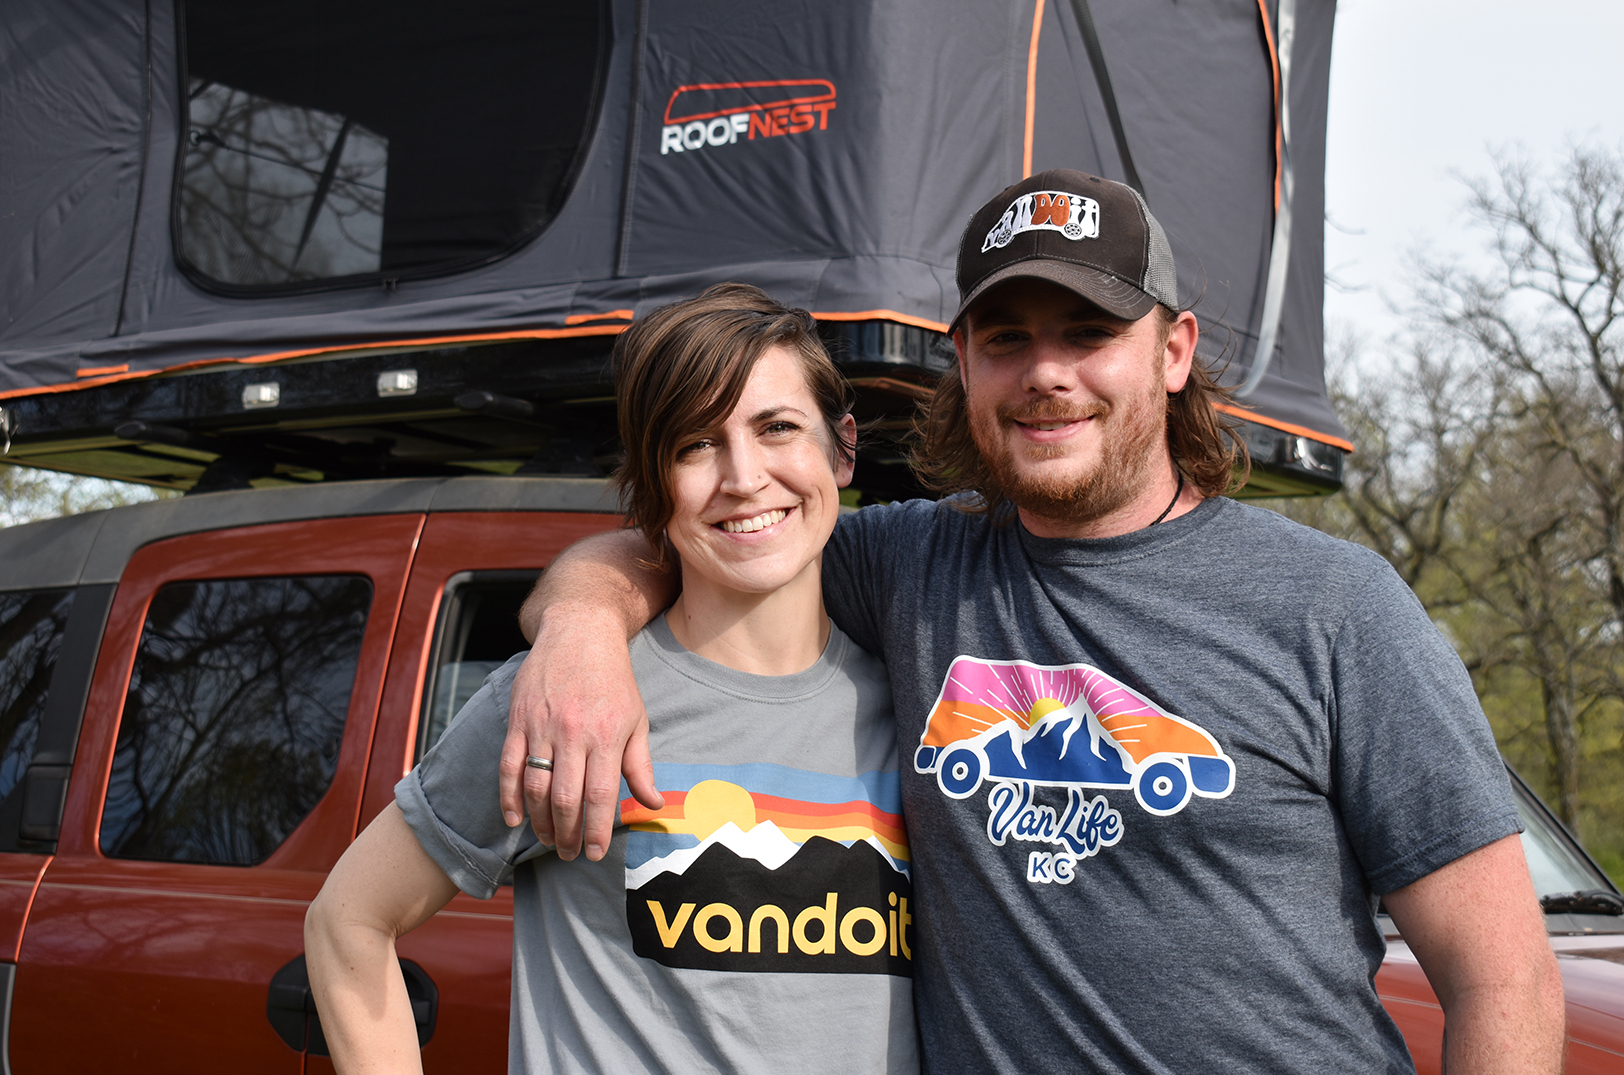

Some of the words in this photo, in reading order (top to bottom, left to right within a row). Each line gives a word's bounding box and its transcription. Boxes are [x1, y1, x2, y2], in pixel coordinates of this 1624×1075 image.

[660, 101, 837, 155] ROOFNEST
[989, 780, 1053, 843] Van
[1056, 788, 1120, 856] Life
[1030, 855, 1072, 881] KC
[646, 891, 912, 961] vandoit
